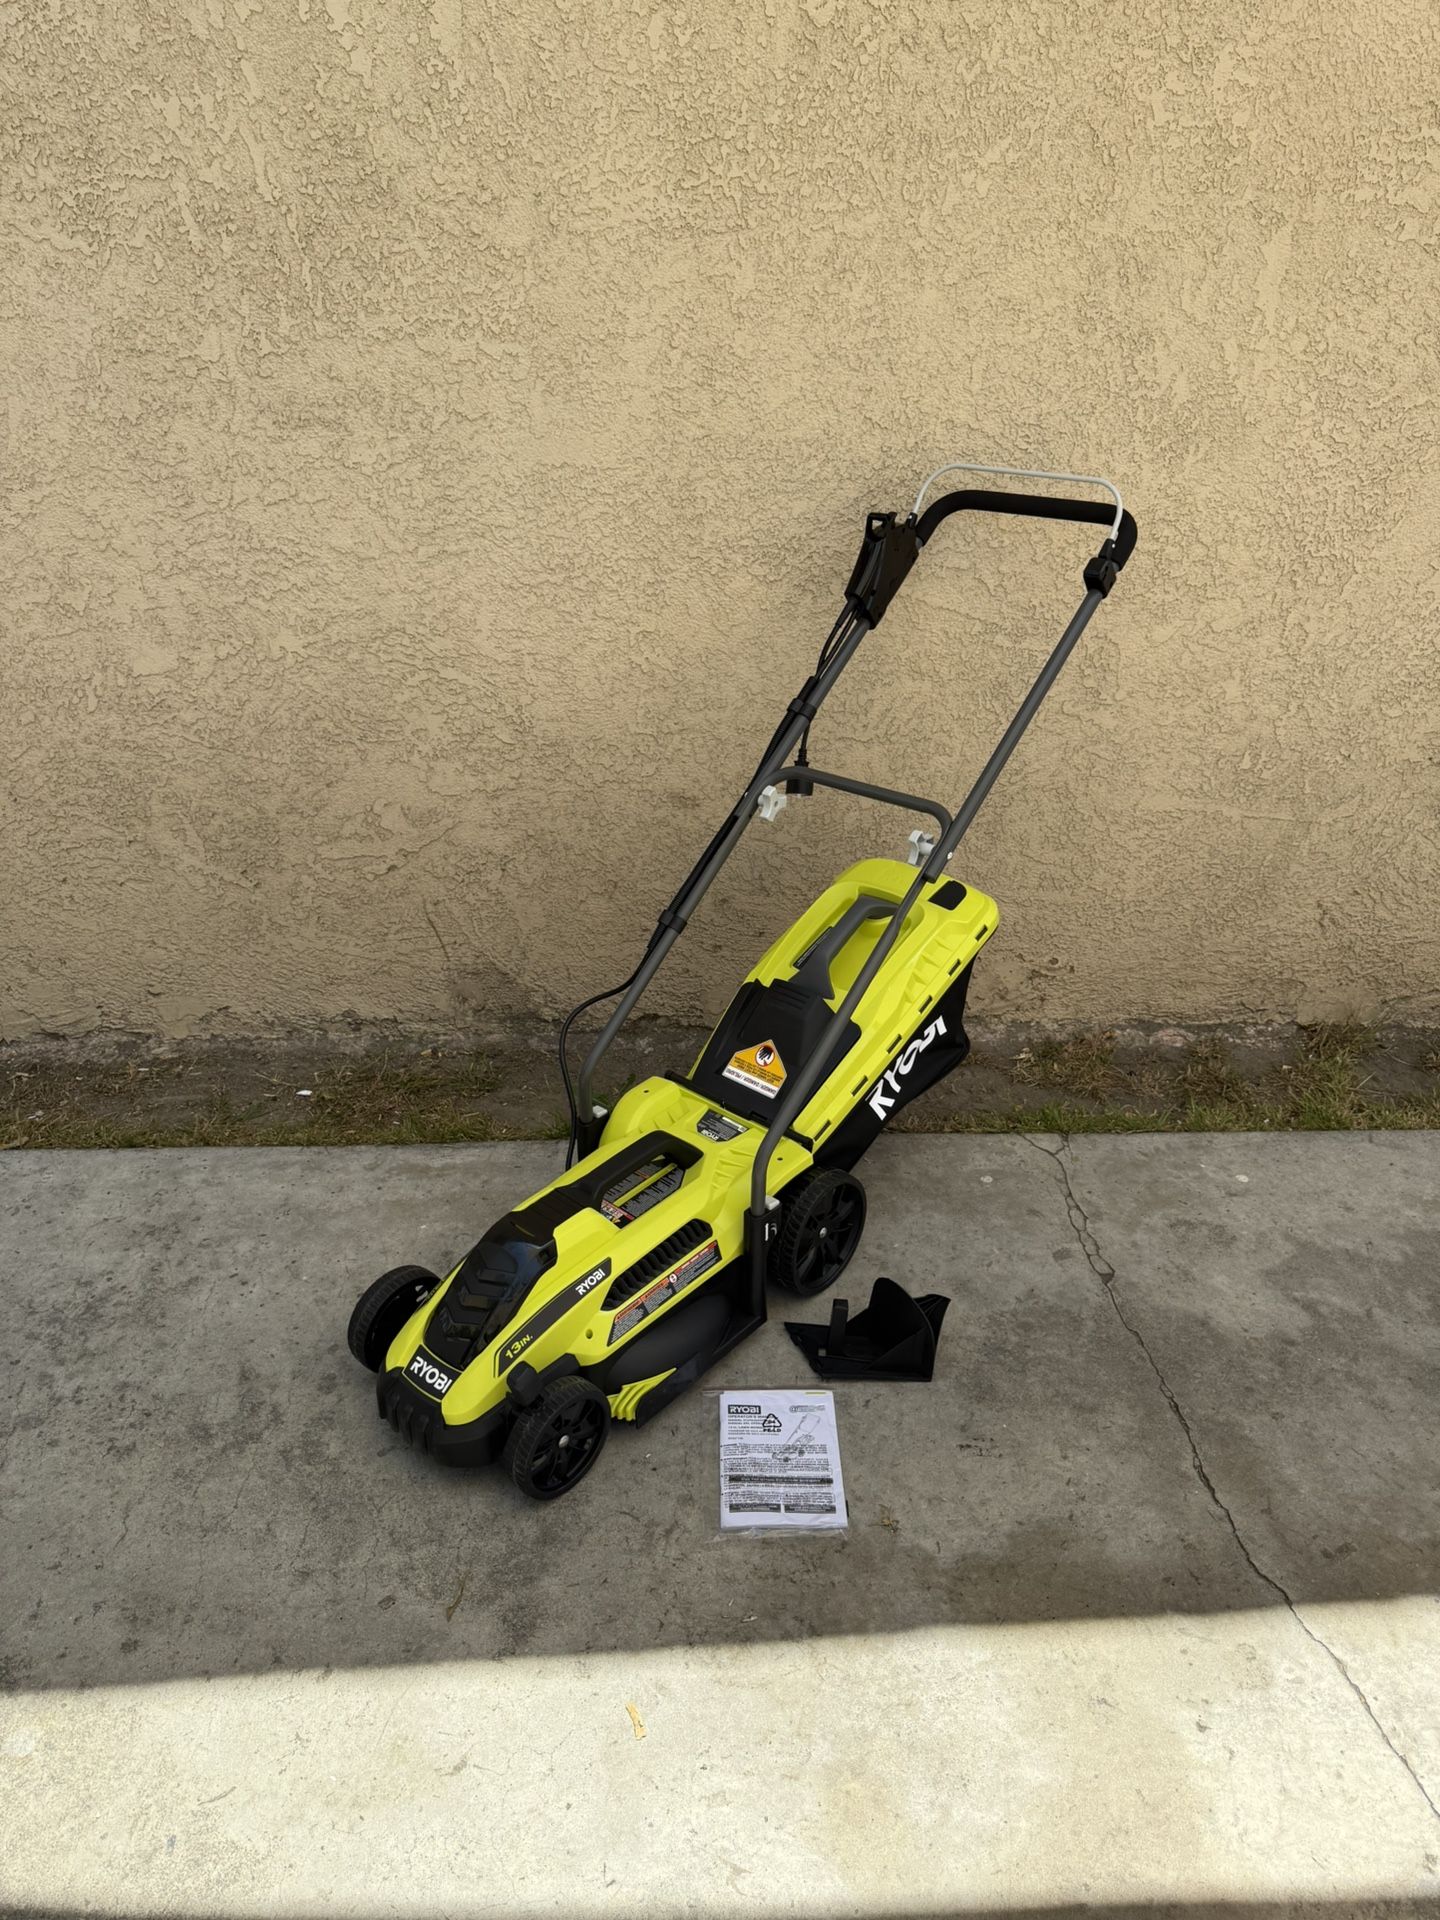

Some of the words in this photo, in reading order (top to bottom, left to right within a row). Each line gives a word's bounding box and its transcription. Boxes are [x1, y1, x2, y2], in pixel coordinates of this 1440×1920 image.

[575, 1268, 606, 1296] RYOBI
[409, 1356, 453, 1394] RYOBI
[729, 1406, 760, 1414] RYOBI
